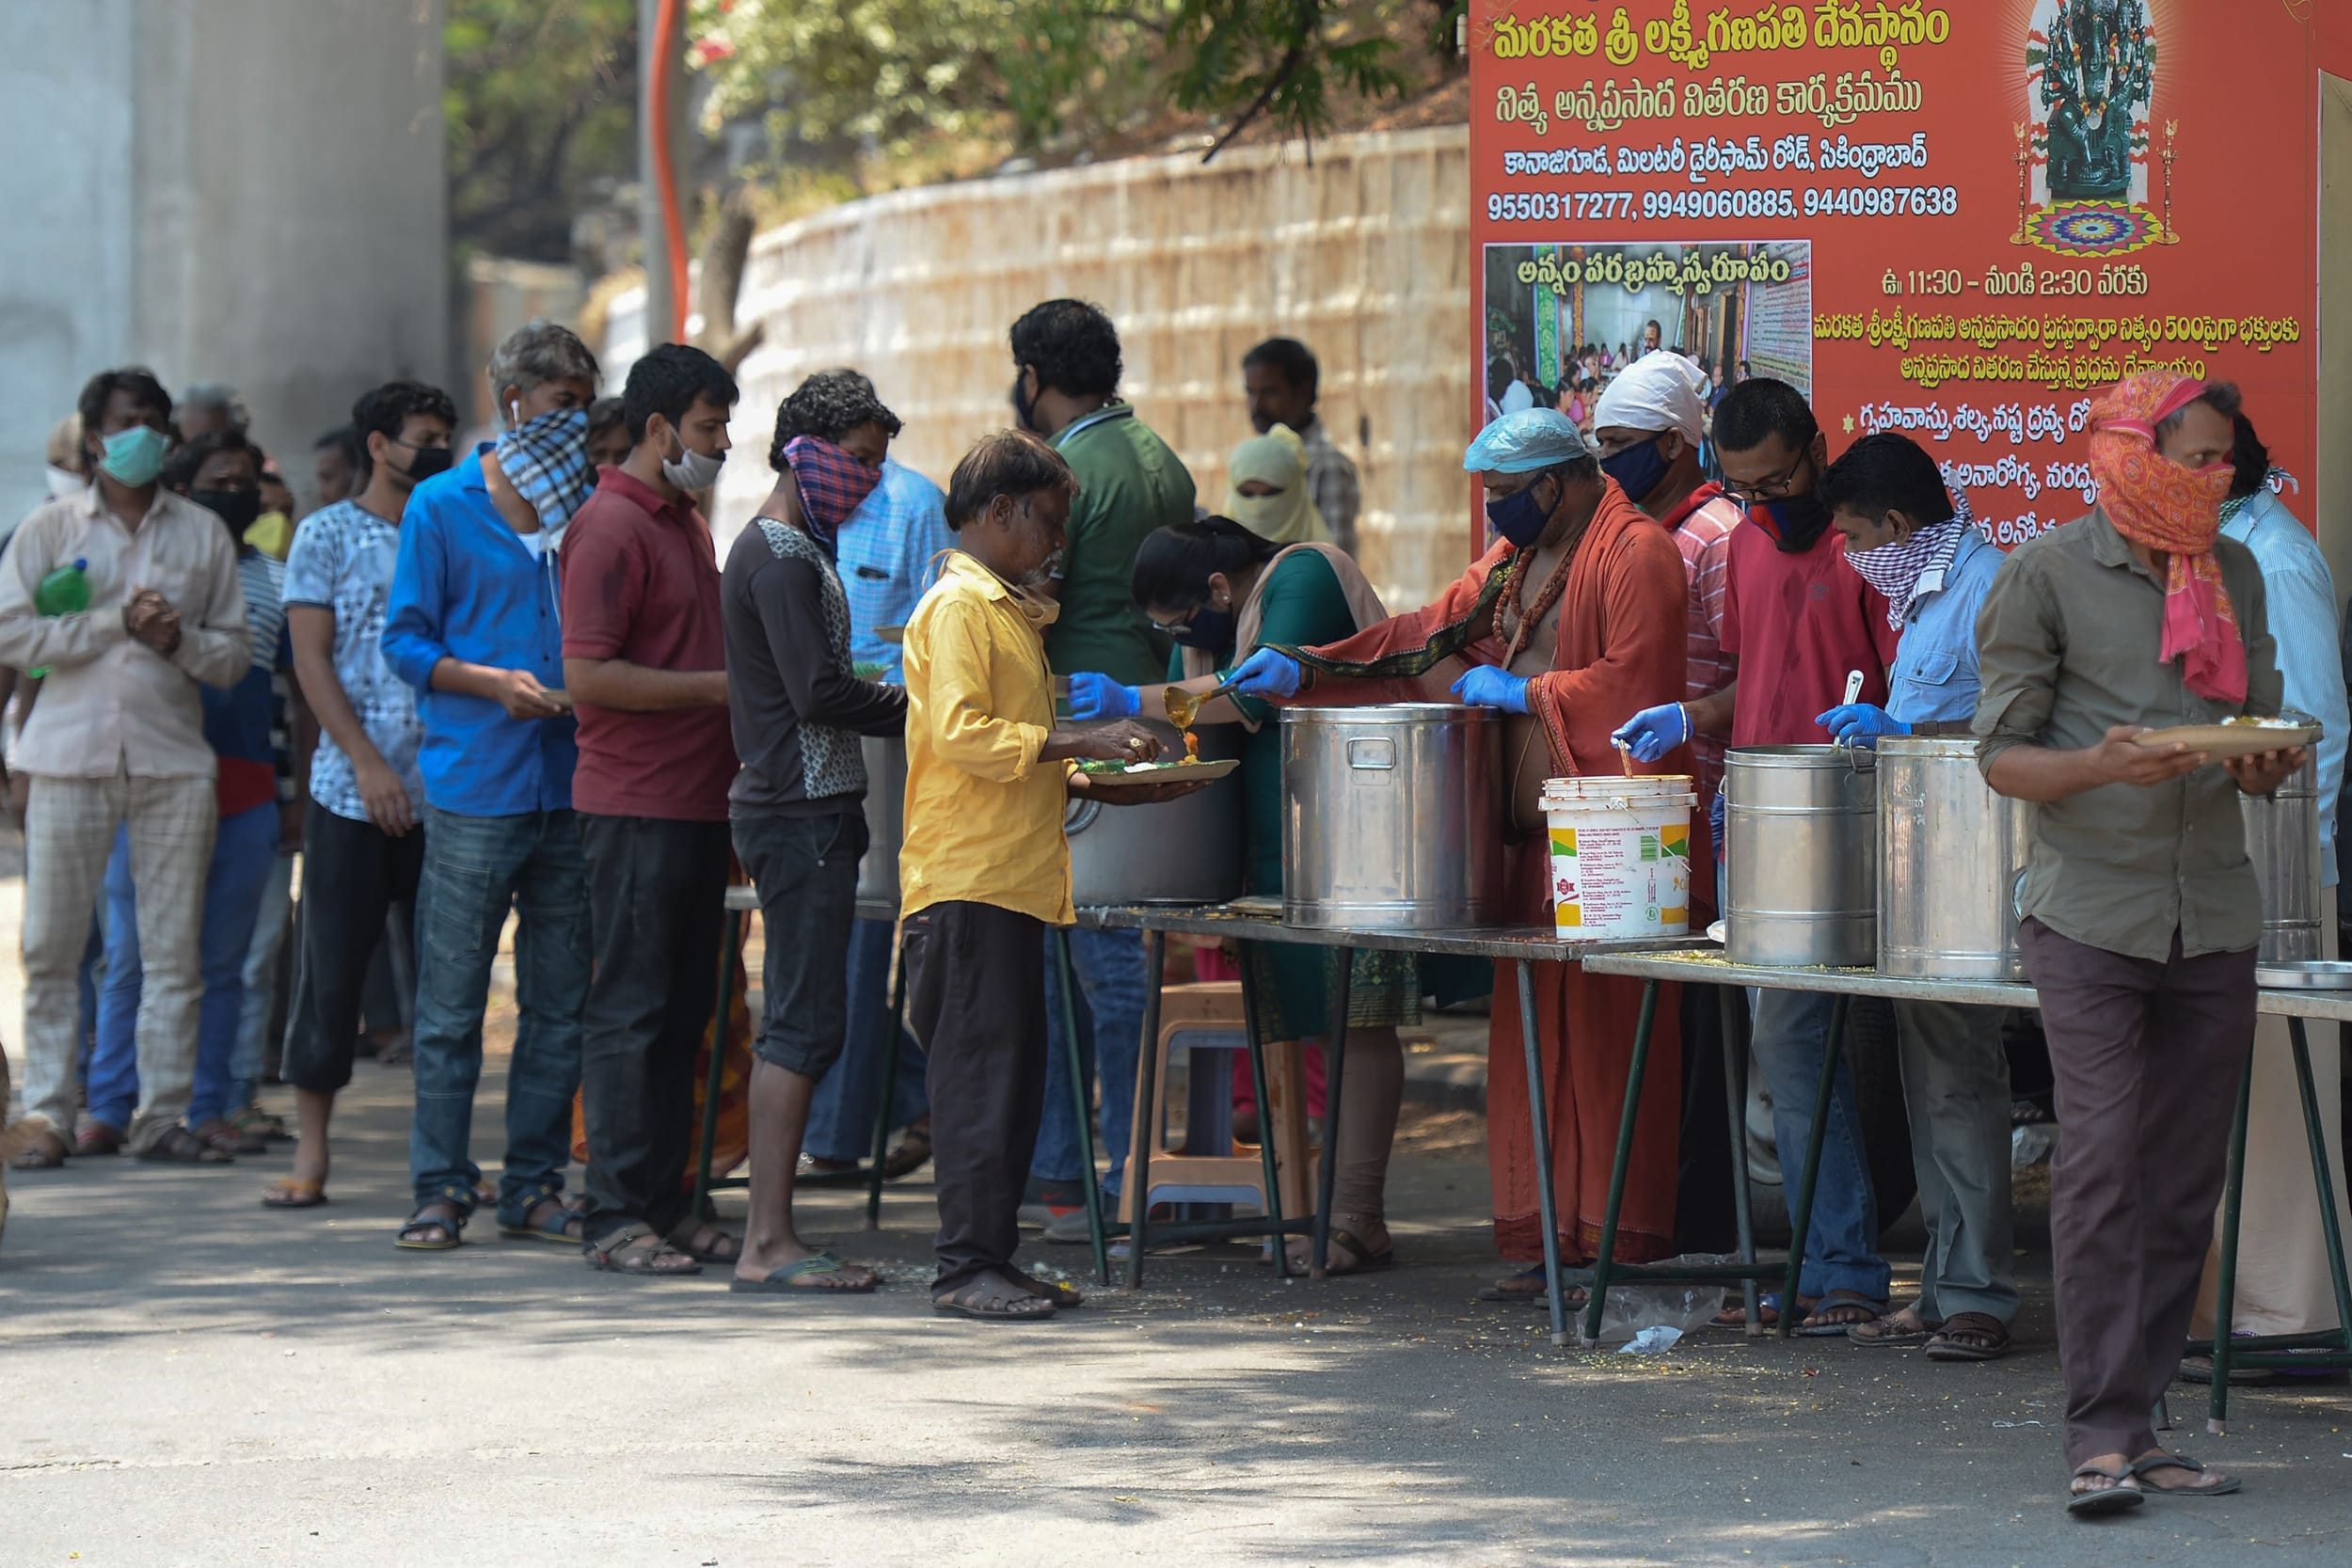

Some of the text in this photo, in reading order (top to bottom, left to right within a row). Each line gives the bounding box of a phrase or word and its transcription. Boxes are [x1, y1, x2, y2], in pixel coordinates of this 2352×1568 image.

[1493, 12, 1598, 58] మరకత
[1604, 8, 1639, 65] శ్రీ
[1814, 0, 1950, 71] దేవస్థానం
[1496, 68, 1922, 135] నిత్య అన్నప్రసాద వితరణ కార్యక్రమము
[1503, 133, 1928, 183] కానాజిగూడ, మిలటరీ డైరీఫామ్ రోడ్, సికింద్రాబాద్
[1487, 186, 1958, 221] 9550317277, 9949060885, 9440987638
[1517, 252, 1581, 295] అన్నం
[1909, 269, 1963, 294] 11:30
[1984, 261, 2035, 295] నుండి
[2040, 270, 2092, 295] 2:30
[2097, 263, 2148, 294] వరకు
[1813, 314, 1864, 339] మరకత
[1958, 315, 2040, 349] అన్నప్రసాదం
[2120, 315, 2162, 352] నిత్యం
[2240, 316, 2299, 351] భక్తులకు
[1900, 355, 1970, 388] అన్నప్రసాద
[1973, 355, 2024, 380] వితరణ
[2026, 346, 2074, 389] చేస్తున్న
[2026, 404, 2065, 443] ద్రవ్య
